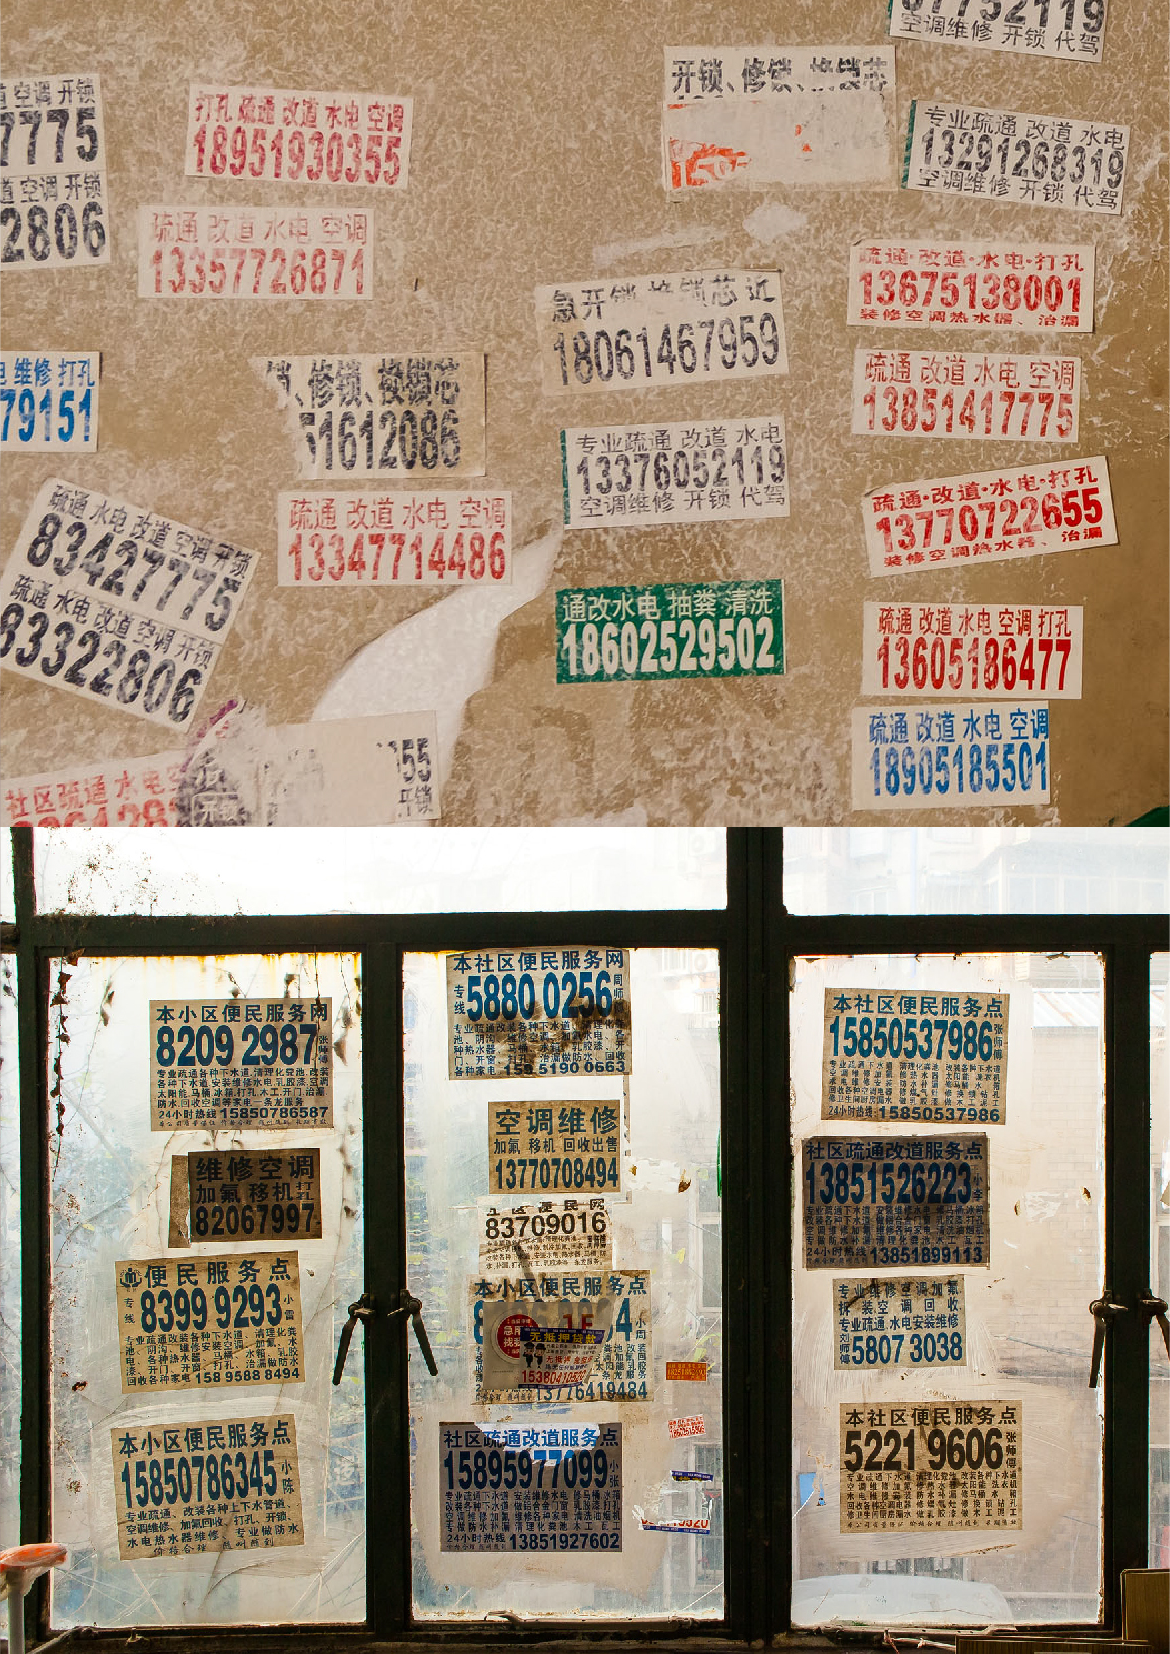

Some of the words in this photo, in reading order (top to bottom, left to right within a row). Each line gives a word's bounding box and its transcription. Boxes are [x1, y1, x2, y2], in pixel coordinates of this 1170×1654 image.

[1002, 25, 1046, 49] 开锁
[192, 124, 402, 185] 18951930355
[1081, 127, 1125, 152] 水电
[921, 127, 1125, 190] 13291268319
[0, 201, 106, 263] 2806
[264, 215, 311, 246] 水电
[320, 213, 368, 246] 空调
[150, 246, 364, 294] 13357726871
[859, 269, 1081, 311] 13675138001
[554, 312, 779, 385] 18061467959
[920, 354, 967, 386] 改道
[974, 356, 1020, 390] 水电
[1029, 359, 1076, 391] 空调
[0, 388, 91, 443] 79151
[863, 386, 1073, 438] 13851417775
[681, 426, 727, 449] 改道
[736, 422, 782, 444] 水电
[577, 446, 785, 495] 13376052119
[288, 497, 338, 530] 疏通
[346, 497, 395, 530] 改道
[402, 497, 449, 530] 水电
[457, 496, 506, 530] 空调
[876, 487, 1104, 553] 13770722655
[27, 512, 242, 632] 83427775
[288, 532, 506, 581] 13347714486
[668, 588, 717, 618] 抽粪
[725, 587, 773, 617] 清洗
[878, 606, 912, 636] 疏通
[918, 607, 953, 636] 改道
[959, 608, 993, 636] 水电
[998, 608, 1032, 637] 空调
[1038, 608, 1072, 637] 打孔
[0, 601, 203, 723] 83322806
[562, 617, 774, 676] 18602529502
[876, 636, 1072, 690] 13605186477
[868, 711, 910, 746] 疏通
[915, 710, 956, 743] 改道
[962, 708, 1003, 741] 水电
[1009, 708, 1049, 741] 空调
[868, 741, 1047, 796] 18905185501
[453, 950, 624, 974] 本社区便民服务网
[453, 985, 466, 1015] 专线
[466, 972, 535, 1022] 5880
[543, 970, 613, 1019] 0256
[833, 994, 1003, 1018] 本社区便民服务点
[155, 1003, 328, 1024] 本小区便民服务网
[156, 1024, 234, 1067] 8209
[241, 1023, 318, 1066] 2987
[829, 1015, 993, 1062] 15850537986
[538, 1062, 580, 1075] 5190
[584, 1061, 625, 1073] 0663
[158, 1109, 217, 1120] 24小时热线
[220, 1107, 328, 1119] 15850786587
[495, 1106, 618, 1135] 空调维修
[879, 1106, 1000, 1122] 15850537986
[529, 1138, 556, 1154] 移机
[563, 1136, 618, 1153] 回收出售
[805, 1141, 983, 1161] 社区疏通改道服务点
[196, 1155, 314, 1182] 维修空调
[495, 1157, 618, 1189] 13770708494
[805, 1162, 972, 1204] 13851526223
[248, 1182, 293, 1203] 移机
[195, 1203, 315, 1236] 82067997
[485, 1211, 607, 1239] 83709016
[870, 1246, 983, 1264] 13851899113
[145, 1258, 291, 1288] 便民服务点
[473, 1275, 648, 1298] 本小区便民服务点
[123, 1298, 136, 1324] 专线
[140, 1287, 208, 1334] 8399
[214, 1283, 283, 1330] 9293
[852, 1333, 905, 1365] 5807
[909, 1331, 962, 1362] 3038
[195, 1372, 221, 1384] 158
[225, 1370, 261, 1383] 9588
[264, 1367, 300, 1380] 8494
[845, 1406, 1017, 1427] 本社区便民服务点
[118, 1420, 291, 1458] 本小区便民服务点
[443, 1427, 619, 1449] 社区疏通改道服务点
[844, 1428, 915, 1472] 5221
[928, 1428, 1004, 1470] 9606
[121, 1450, 277, 1508] 15850786345
[443, 1449, 608, 1490] 15895977099
[509, 1533, 619, 1550] 13851927602
